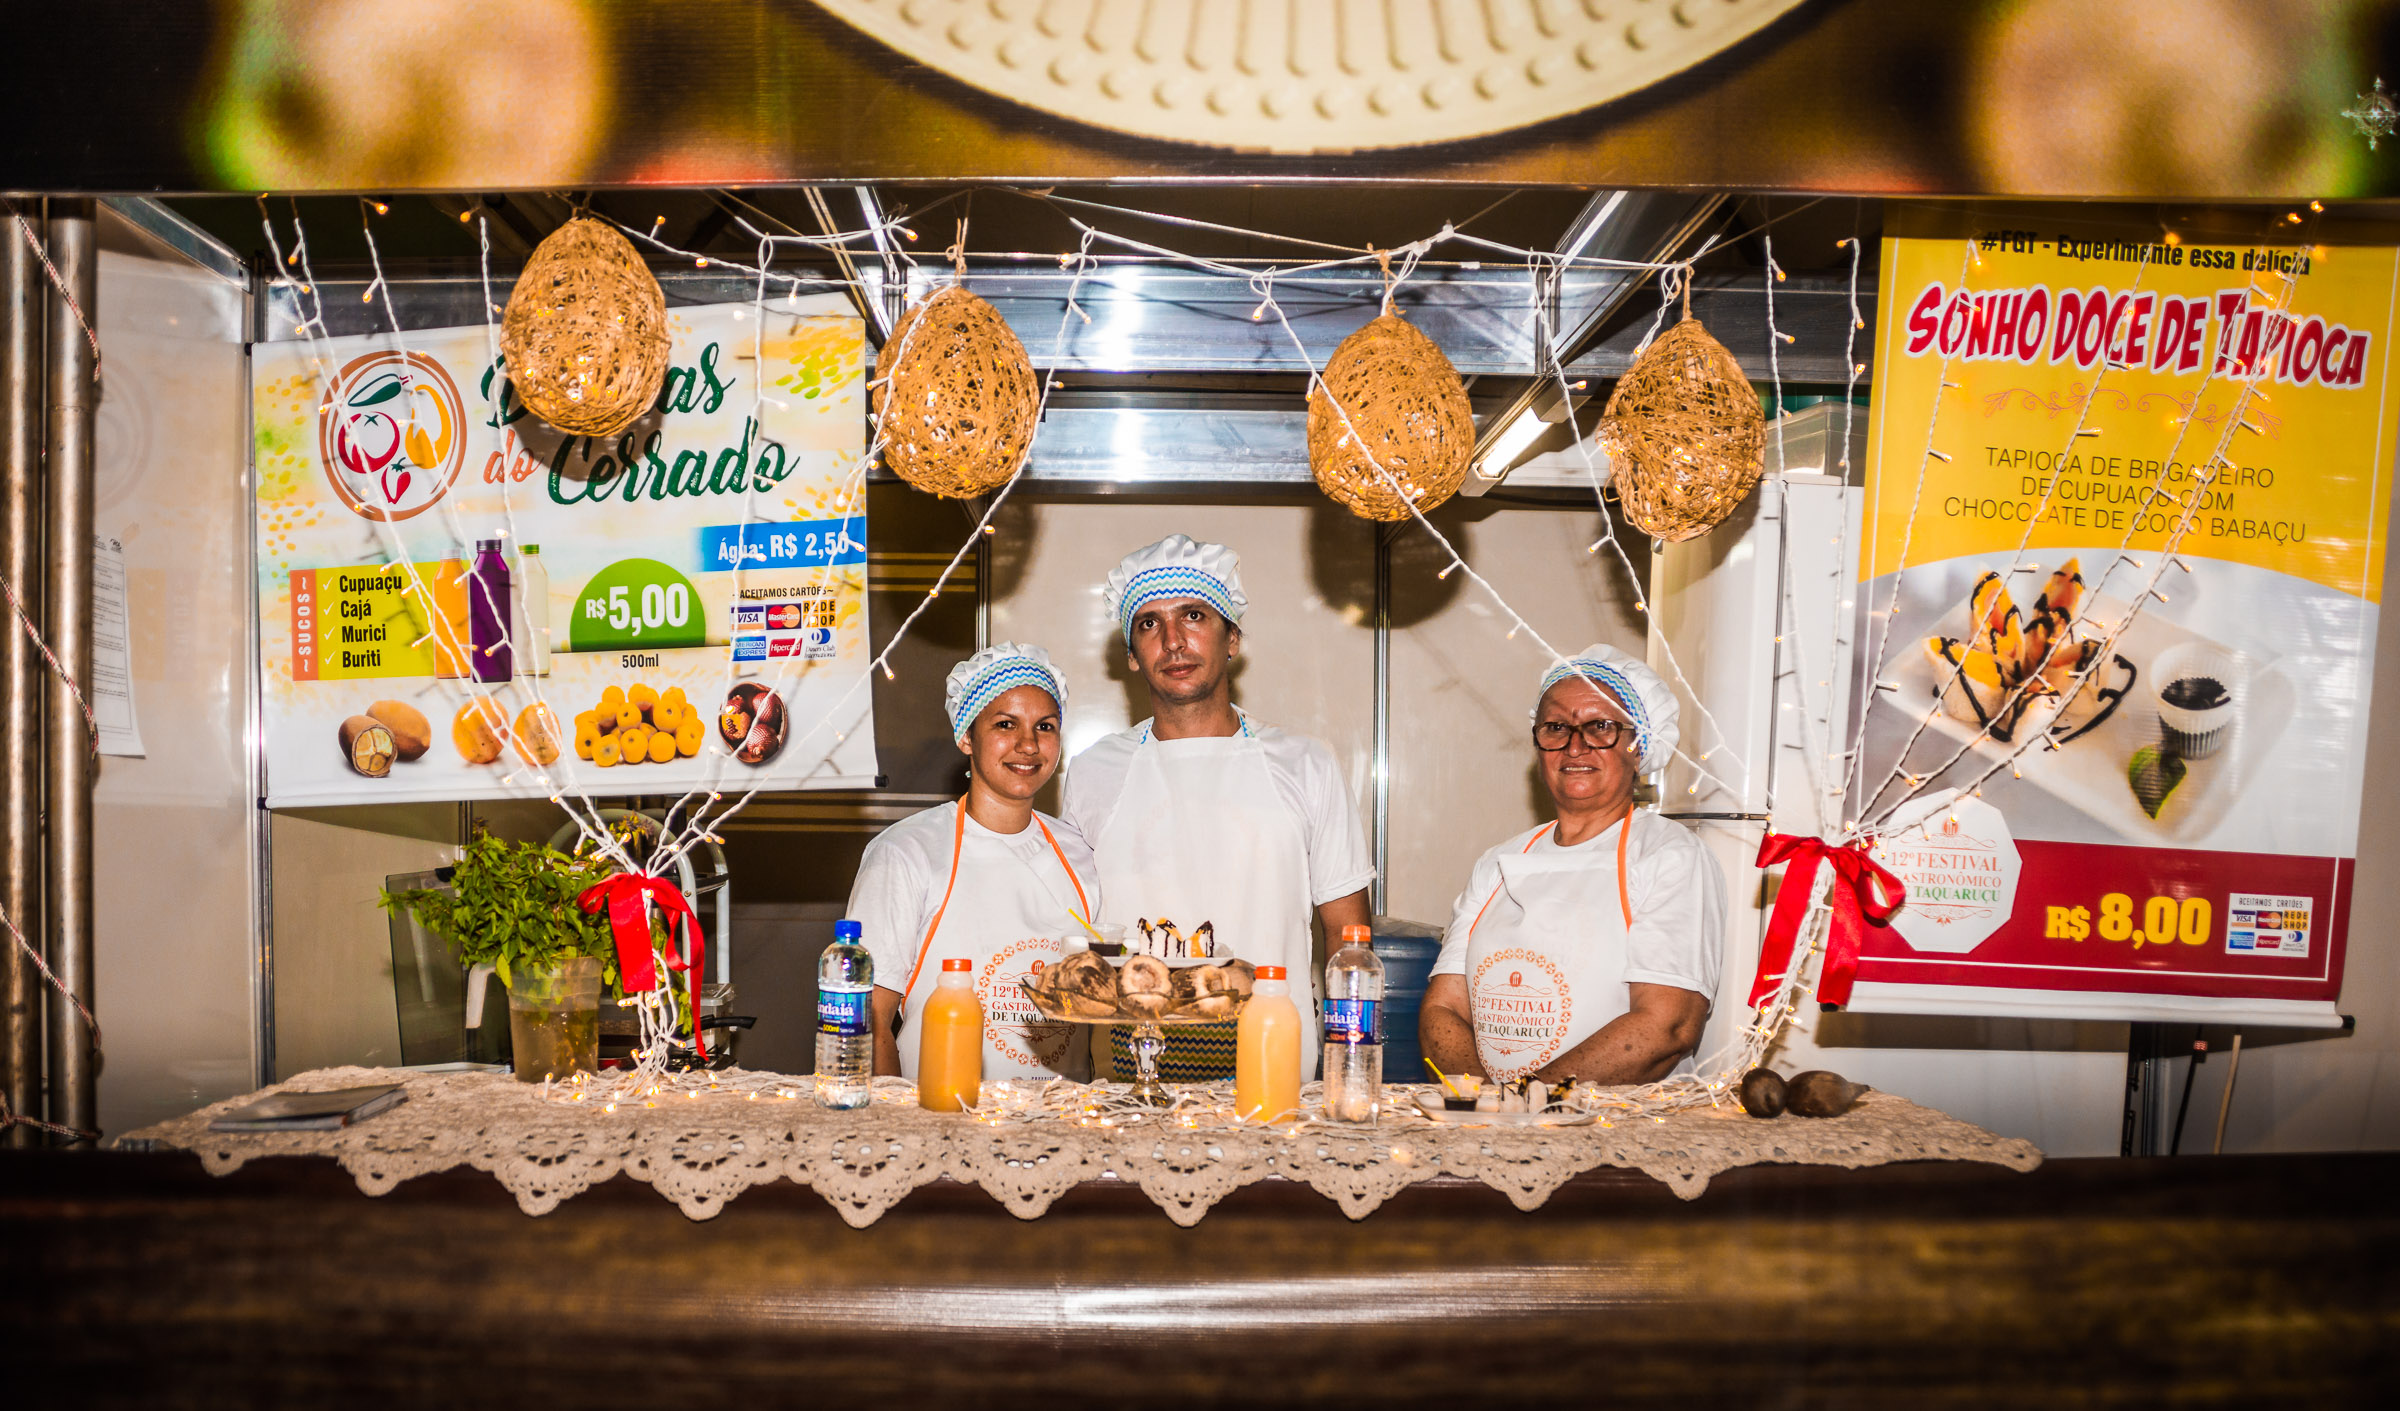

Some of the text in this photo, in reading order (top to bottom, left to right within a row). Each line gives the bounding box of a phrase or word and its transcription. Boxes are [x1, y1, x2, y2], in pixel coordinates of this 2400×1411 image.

[1981, 230, 2038, 254] #FGT
[2056, 234, 2183, 266] Experimente
[2188, 248, 2236, 270] essa
[2242, 248, 2310, 275] delícia
[1904, 281, 2373, 390] SONHO DOCE DE TAPIOCA
[483, 415, 801, 505] do Cerrado
[1985, 446, 2083, 474] TAPIOCA
[2091, 456, 2123, 478] DE
[2022, 476, 2235, 511] DE CUPUAÇU COM
[2094, 509, 2124, 531] DE
[2132, 512, 2202, 536] COCO
[2210, 517, 2306, 547] BABAÇU
[769, 533, 798, 560] R$
[805, 532, 849, 560] 2,50
[339, 575, 402, 596] Cupuaçu
[739, 587, 788, 599] ACEITAMOS
[340, 599, 372, 621] Cajá
[585, 583, 690, 637] R$ 5,00
[737, 613, 759, 623] VISA
[296, 593, 312, 656] SUCOS
[341, 623, 387, 643] Murici
[734, 641, 764, 649] MERICAN
[342, 649, 381, 668] Buriti
[621, 653, 660, 669] 500ml
[1917, 852, 2003, 872] FESTIVAL
[1915, 886, 2001, 904] TAQUARUÇU
[2045, 892, 2212, 950] R$ 8,00
[2236, 914, 2252, 922] VISA
[2283, 910, 2309, 920] REDE
[2283, 920, 2308, 929] SHOP
[1491, 998, 1557, 1014] FESTIVAL
[992, 1011, 1009, 1022] DE
[1477, 1011, 1555, 1027] GASTRONÔMICO
[1477, 1021, 1554, 1040] DE TAQUARUÇU
